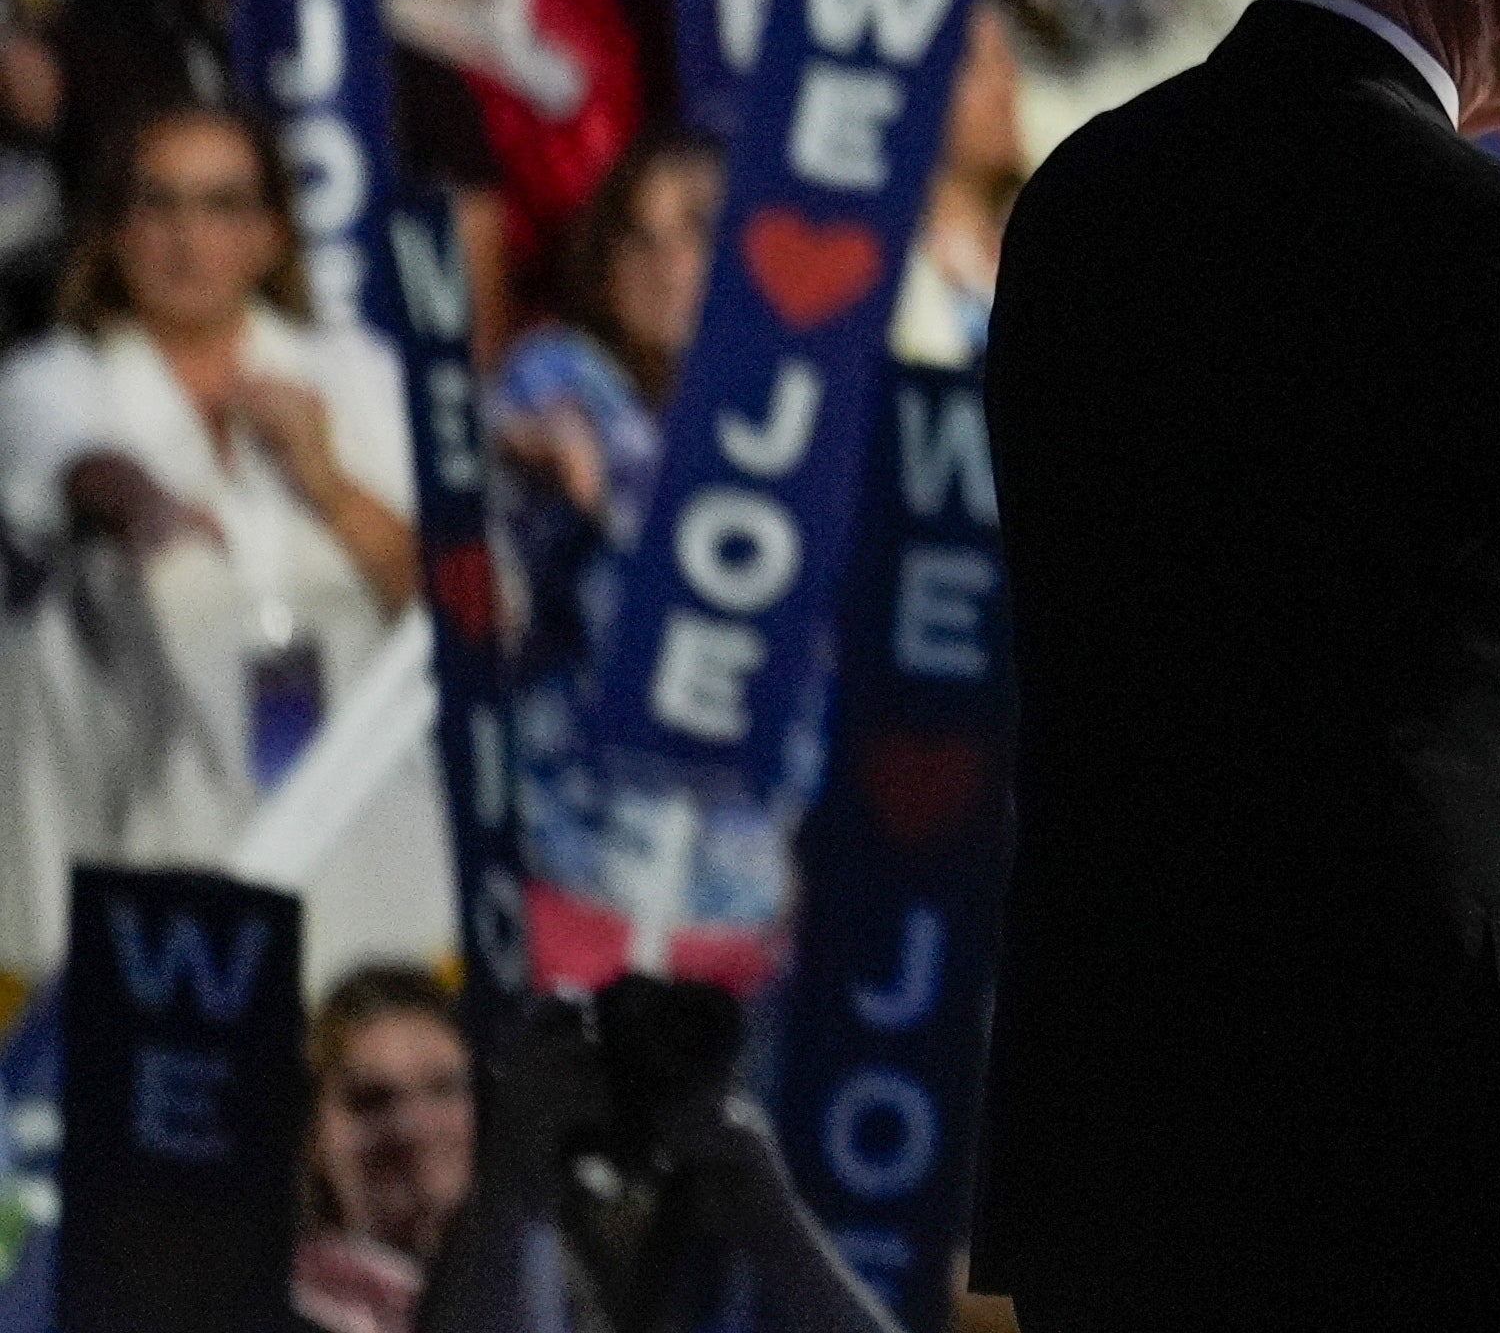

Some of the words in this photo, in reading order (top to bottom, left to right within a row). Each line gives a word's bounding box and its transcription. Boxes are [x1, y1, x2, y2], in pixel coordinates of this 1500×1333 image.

[650, 361, 822, 740] JOE
[105, 901, 272, 1165] WE
[818, 909, 945, 1198] JO
